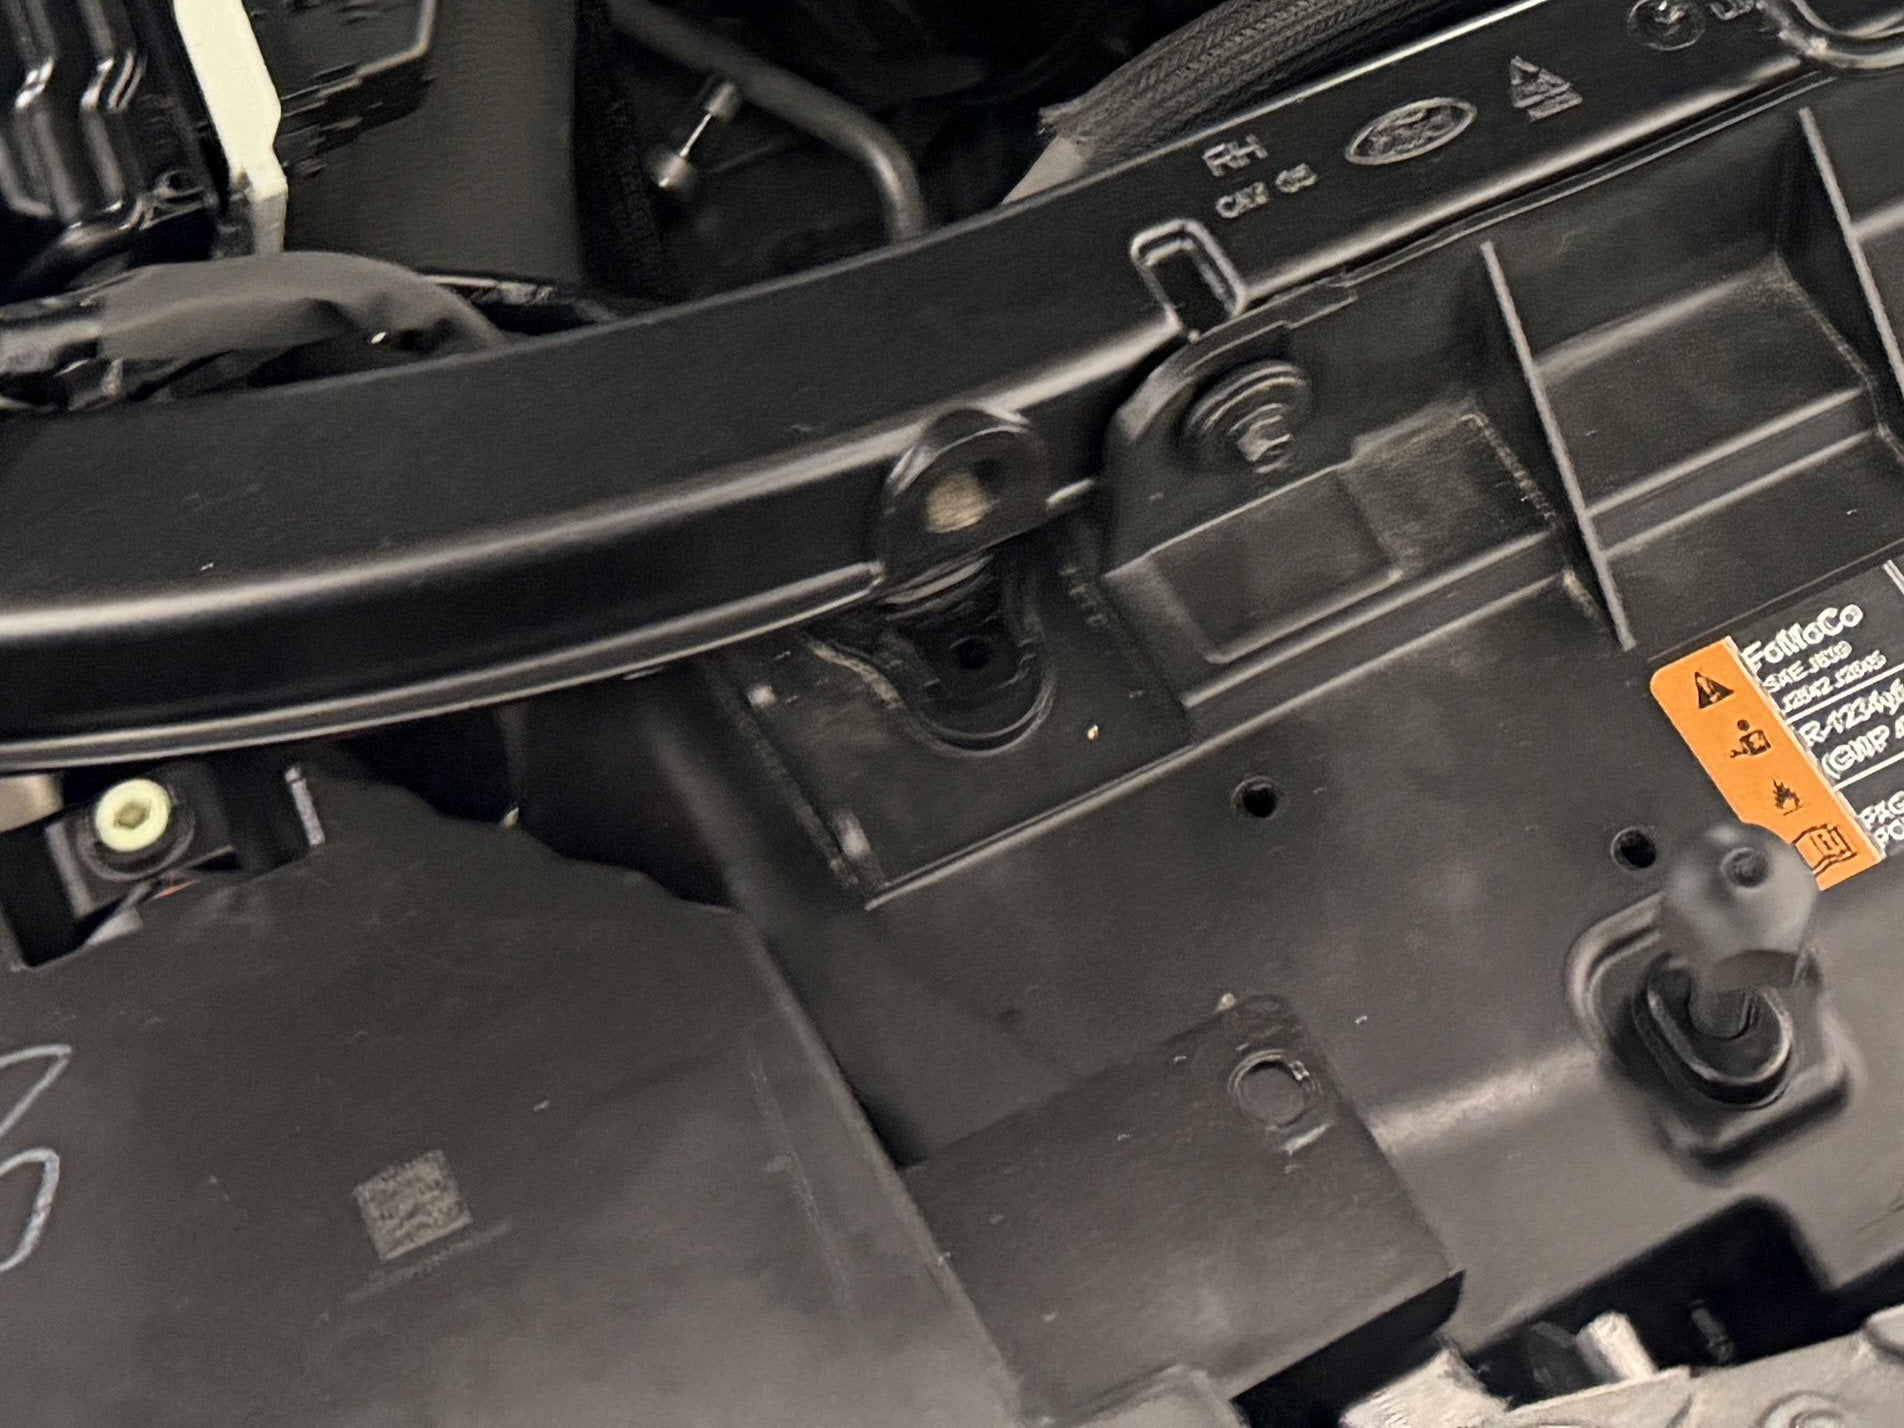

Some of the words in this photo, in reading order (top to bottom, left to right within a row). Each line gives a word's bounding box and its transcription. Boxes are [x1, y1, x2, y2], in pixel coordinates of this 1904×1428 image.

[1201, 133, 1270, 177] RH
[1736, 604, 1862, 672] FoMoCo
[1757, 660, 1809, 694] SAE
[1814, 724, 1890, 779] (GWP
